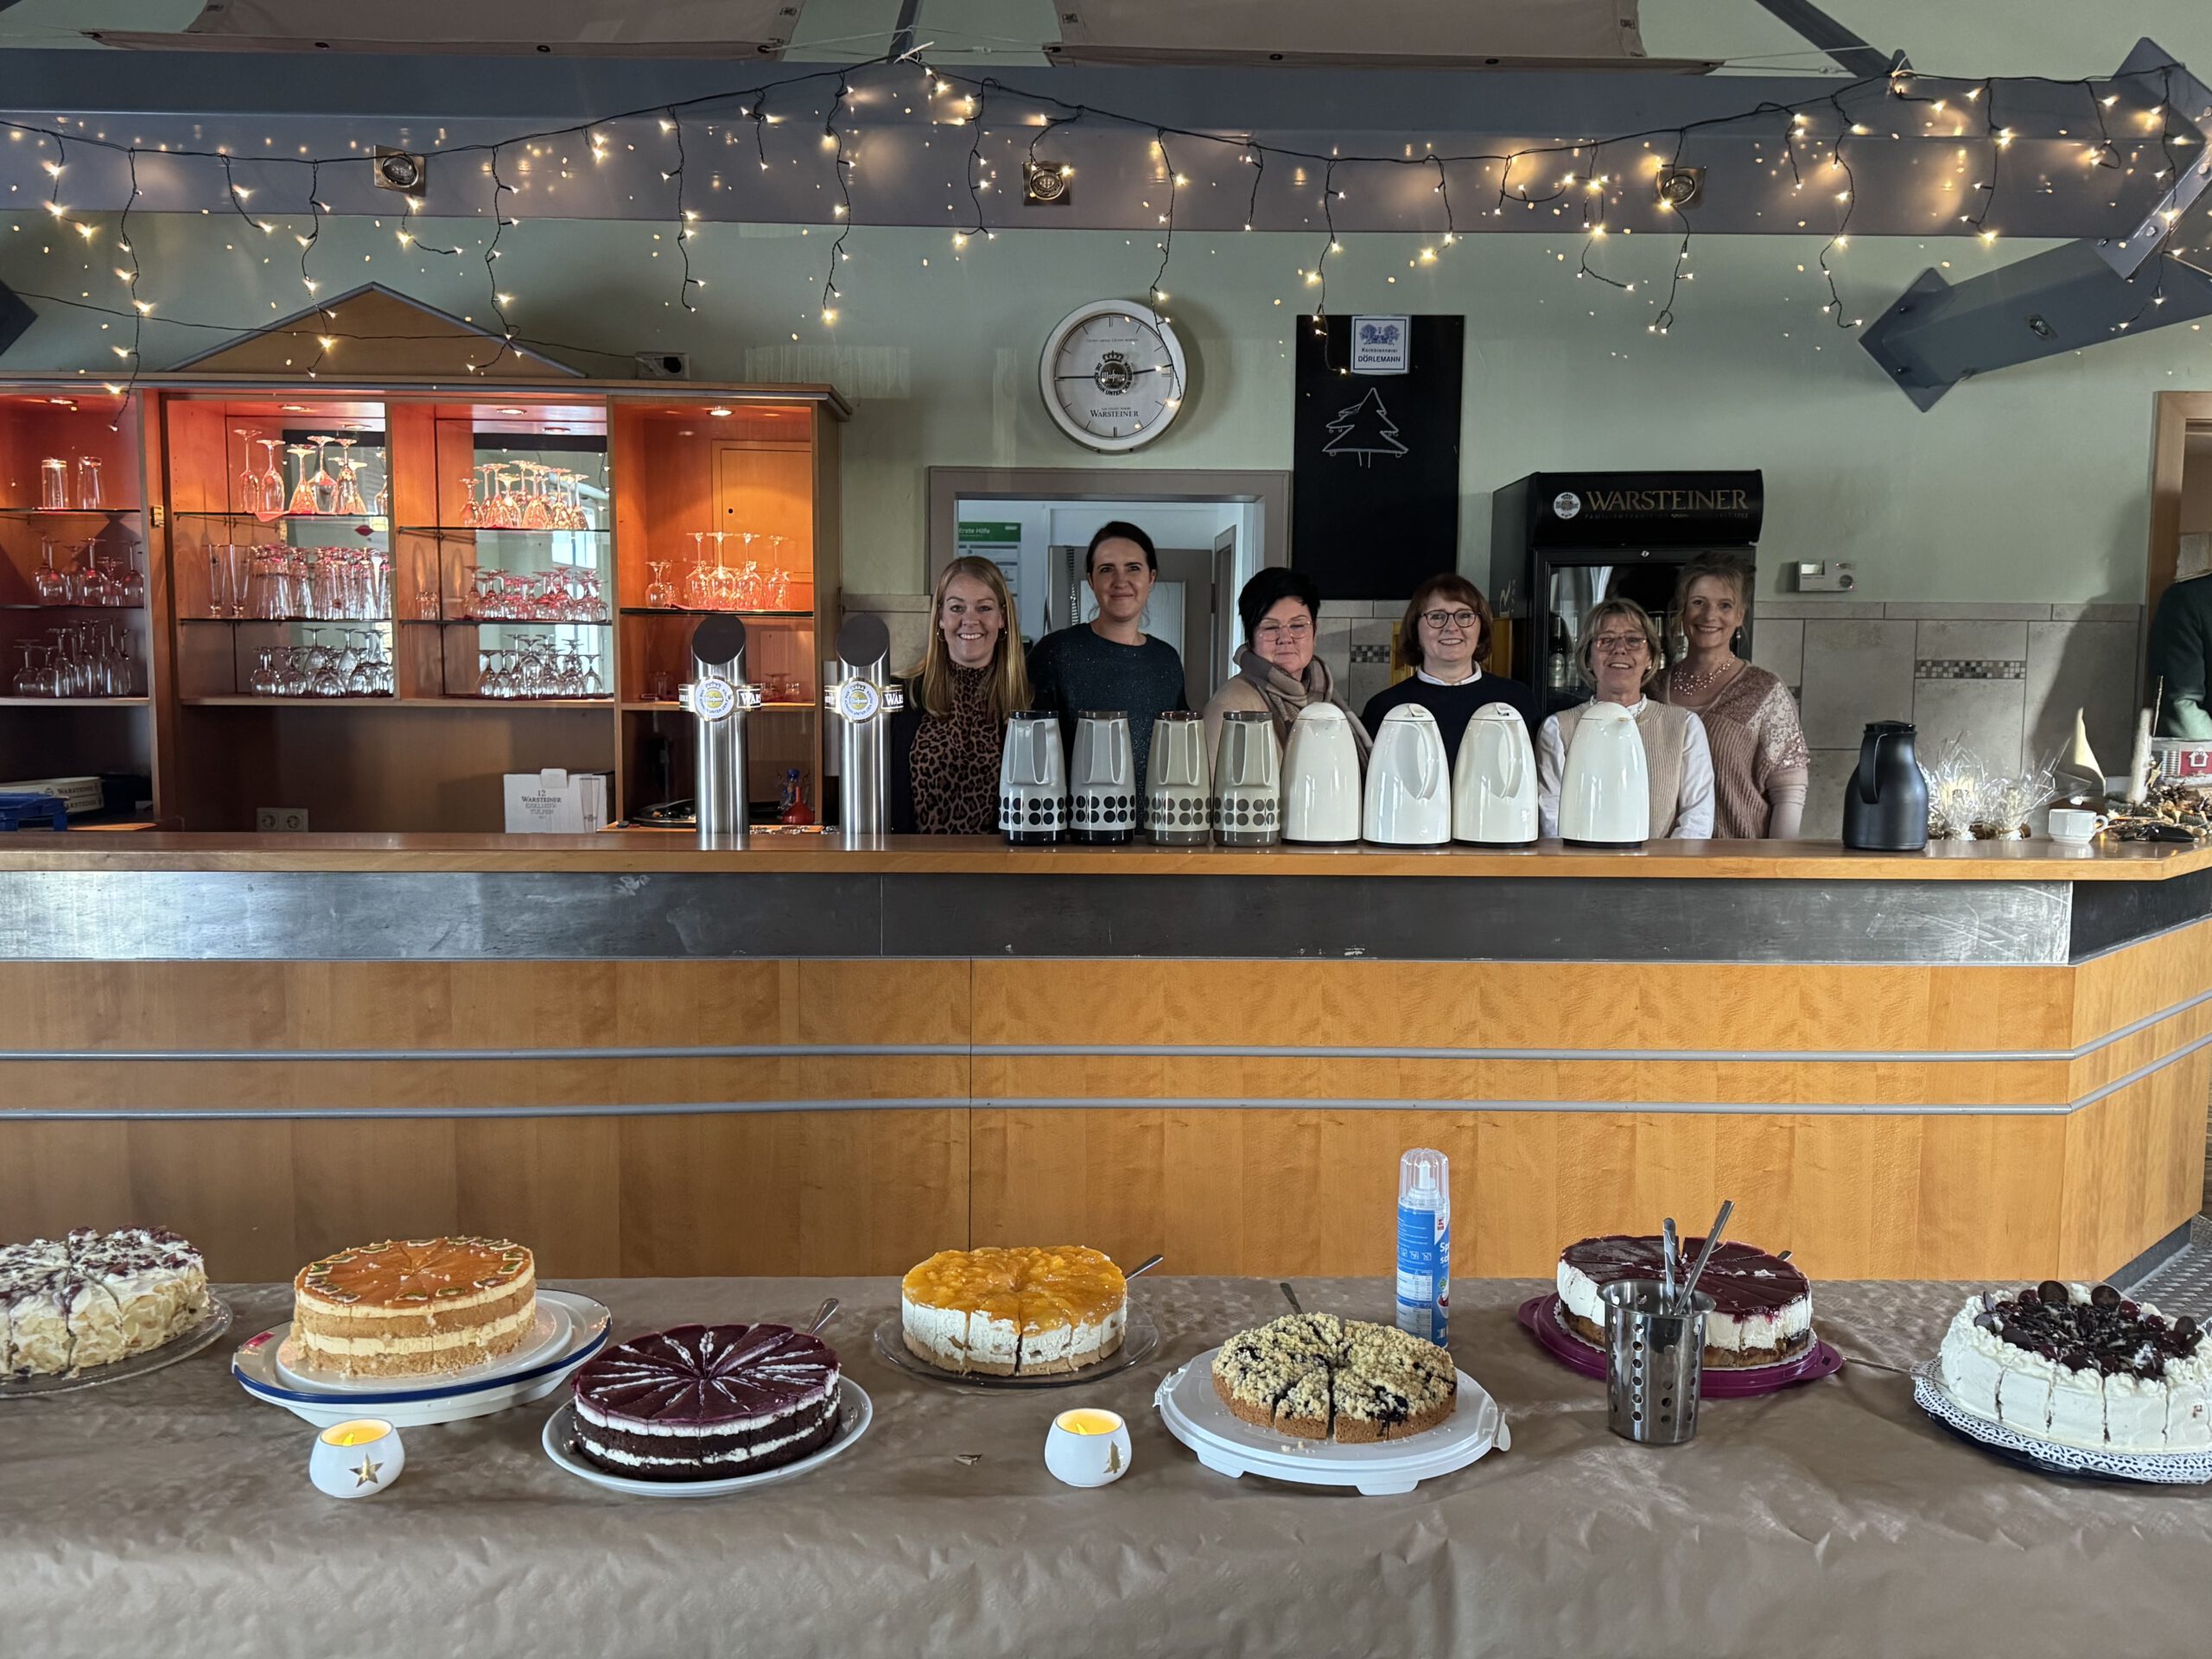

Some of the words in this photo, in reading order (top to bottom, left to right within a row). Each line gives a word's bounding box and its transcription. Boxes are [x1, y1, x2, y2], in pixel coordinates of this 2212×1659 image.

[1357, 354, 1401, 363] DÖRLEMANN
[1090, 410, 1139, 418] WARSTEINER
[1586, 490, 1748, 511] WARSTEINER
